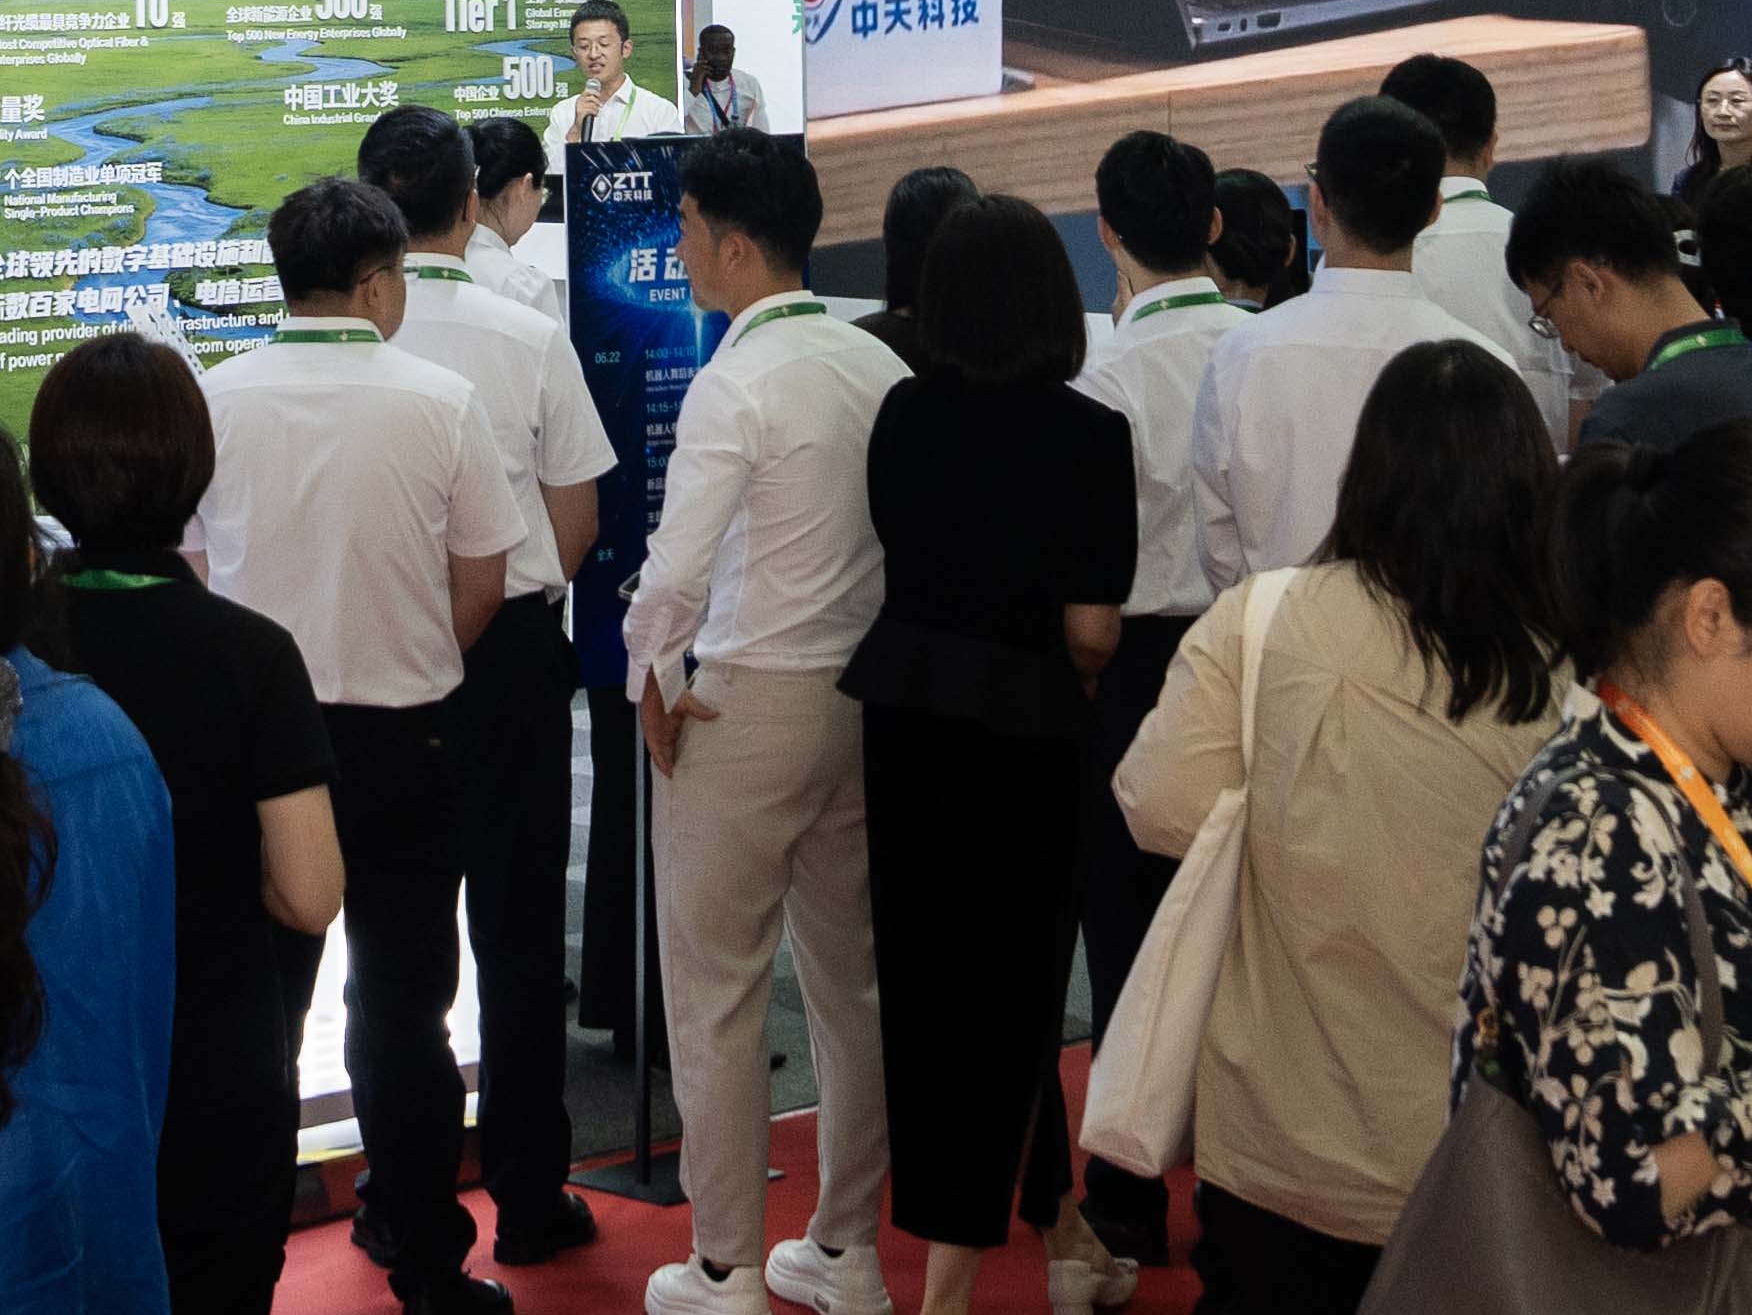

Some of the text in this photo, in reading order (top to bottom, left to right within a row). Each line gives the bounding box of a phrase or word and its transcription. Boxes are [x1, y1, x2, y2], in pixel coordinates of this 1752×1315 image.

[226, 5, 312, 25] 全球新能源企业
[18, 37, 76, 52] Competitive
[47, 52, 86, 67] Globally
[454, 56, 553, 102] 中国企业 500
[283, 81, 399, 111] 中国工业大奖
[16, 128, 48, 141] Award
[4, 161, 162, 191] 个全国制造业单项冠军
[613, 172, 653, 189] ZTT
[4, 191, 117, 207] National Manufacturing
[4, 203, 135, 220] Single-Product Champions
[650, 287, 686, 302] EVENT
[41, 325, 94, 347] provider
[8, 354, 52, 371] power
[595, 351, 621, 364] 06.22
